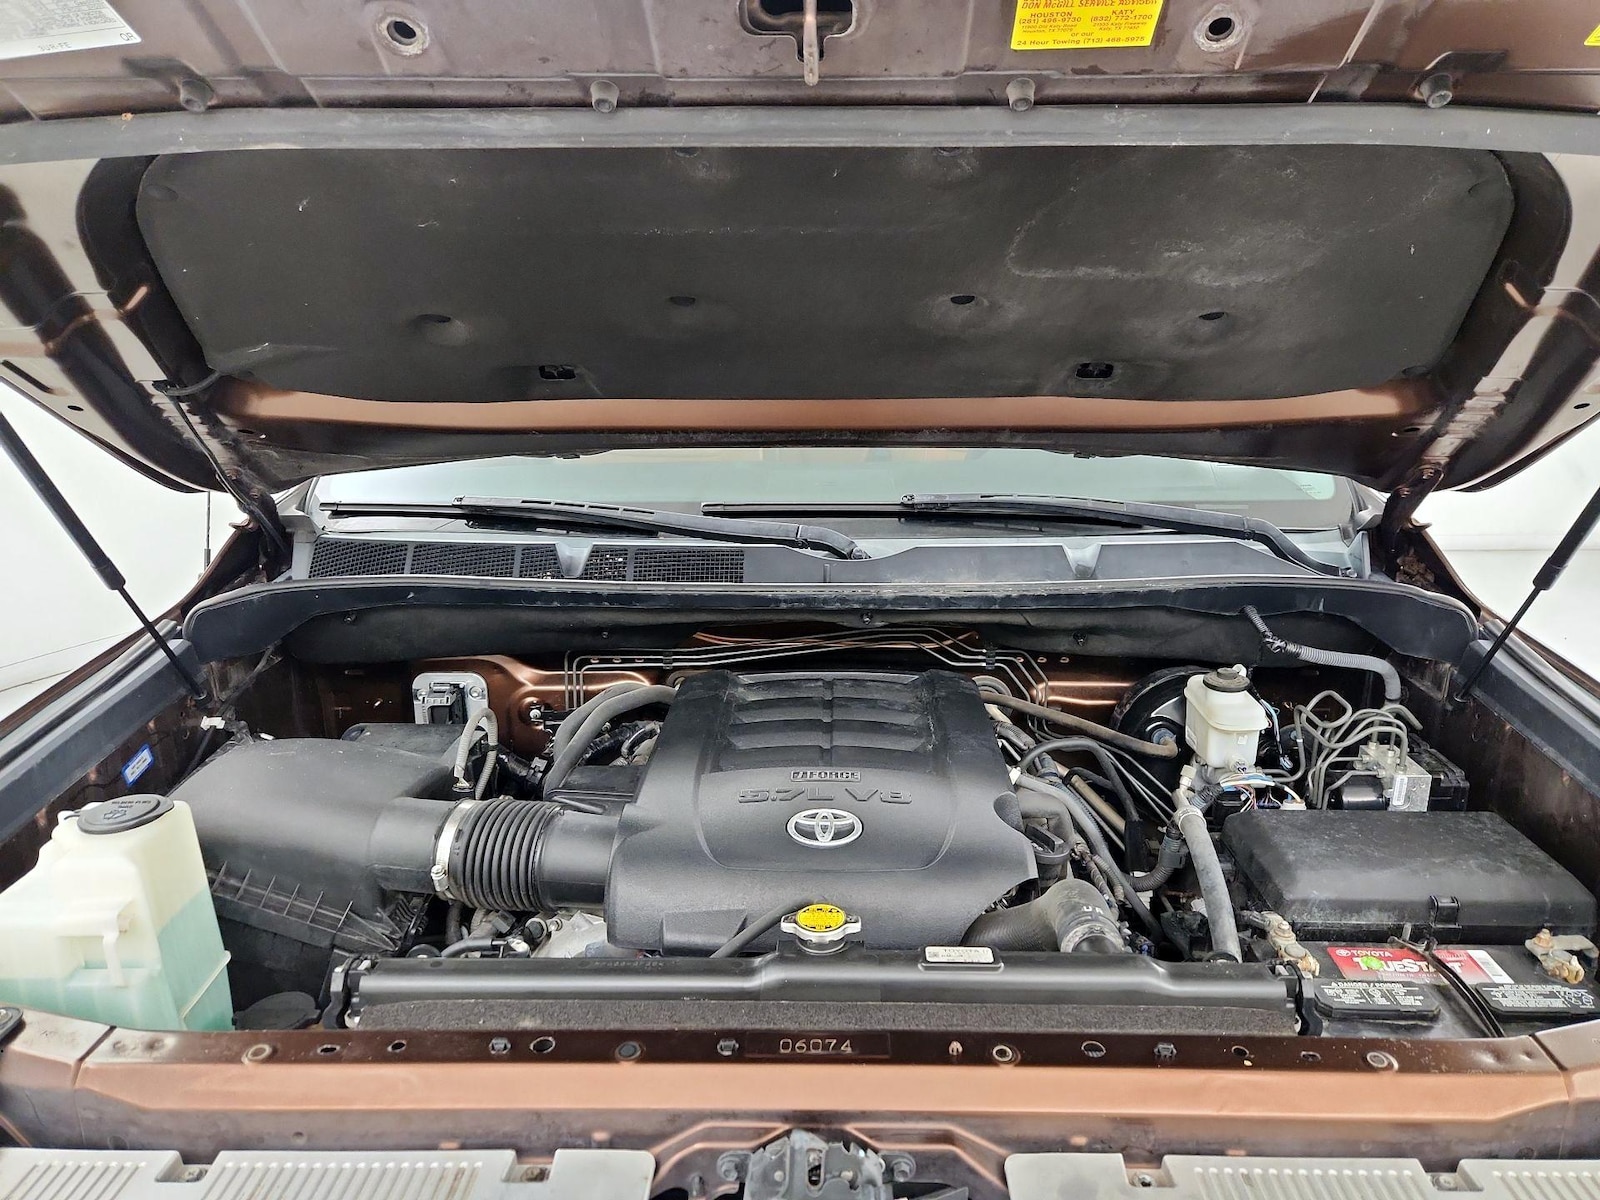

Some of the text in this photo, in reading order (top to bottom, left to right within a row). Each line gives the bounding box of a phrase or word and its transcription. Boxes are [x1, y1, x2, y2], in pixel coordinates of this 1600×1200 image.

[845, 787, 912, 804] V8
[1350, 949, 1393, 958] TOYOTA
[780, 1038, 853, 1054] 06074
